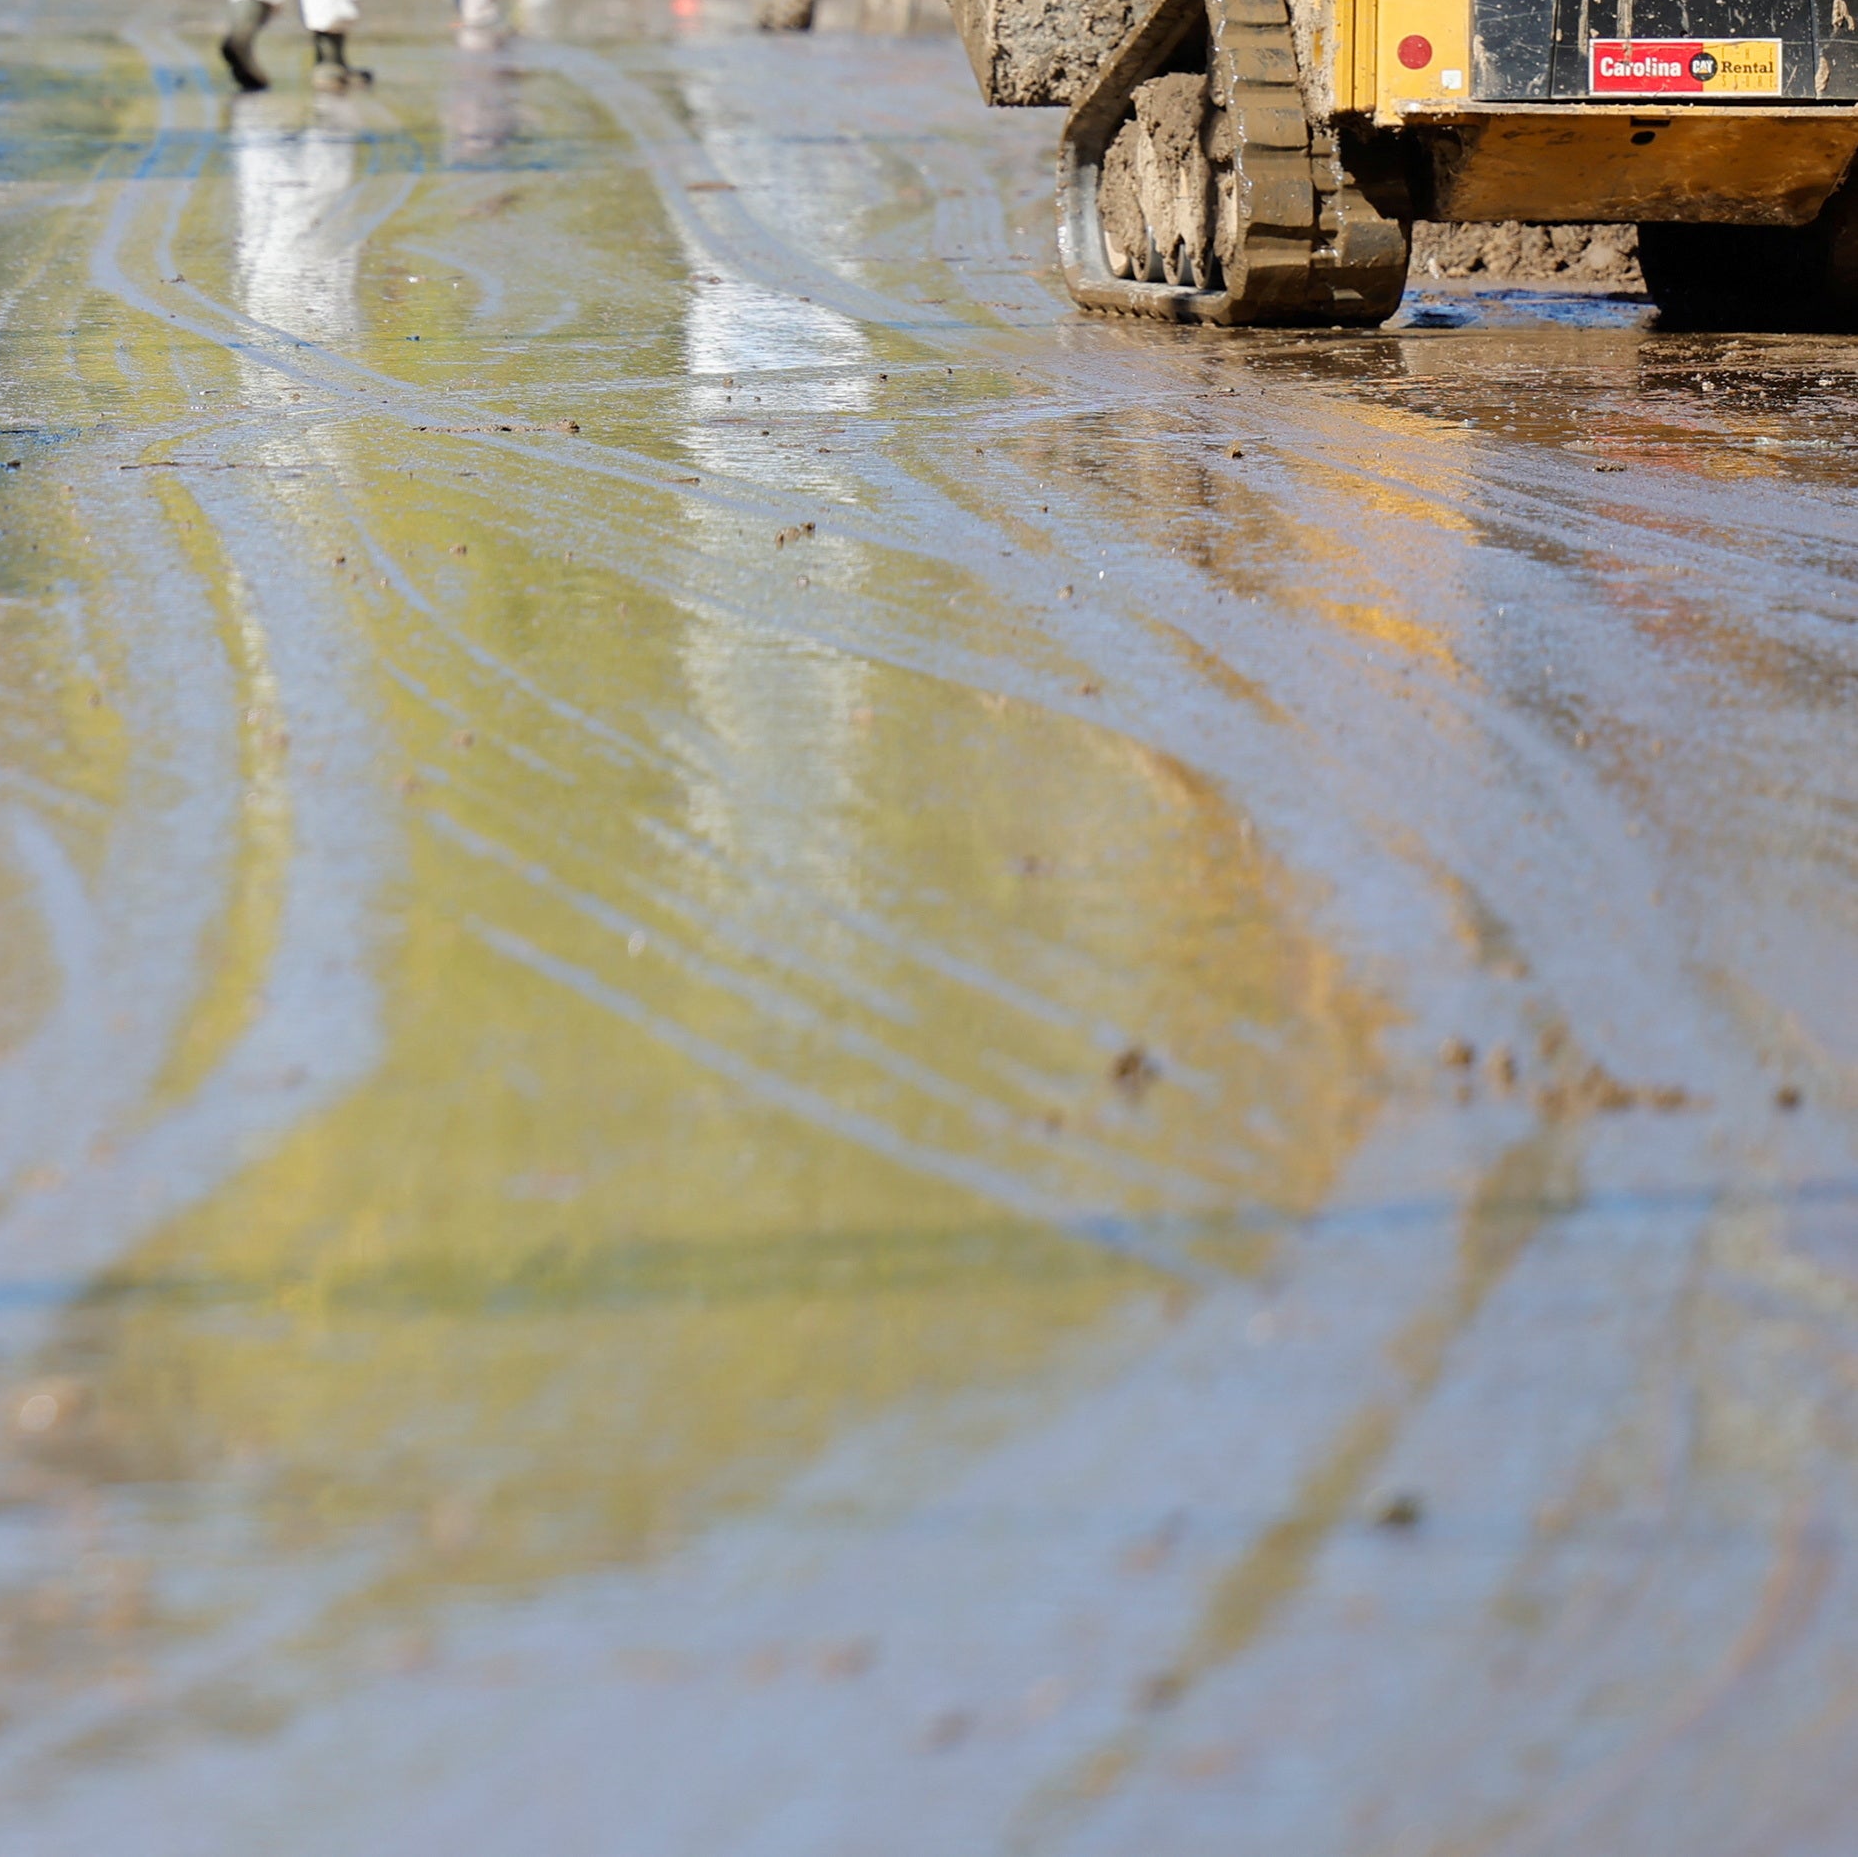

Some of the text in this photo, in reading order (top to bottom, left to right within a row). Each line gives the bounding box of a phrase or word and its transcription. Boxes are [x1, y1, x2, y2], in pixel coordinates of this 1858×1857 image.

[1600, 56, 1682, 78] Carolina
[1691, 59, 1714, 74] CAT
[1720, 61, 1774, 74] Rental
